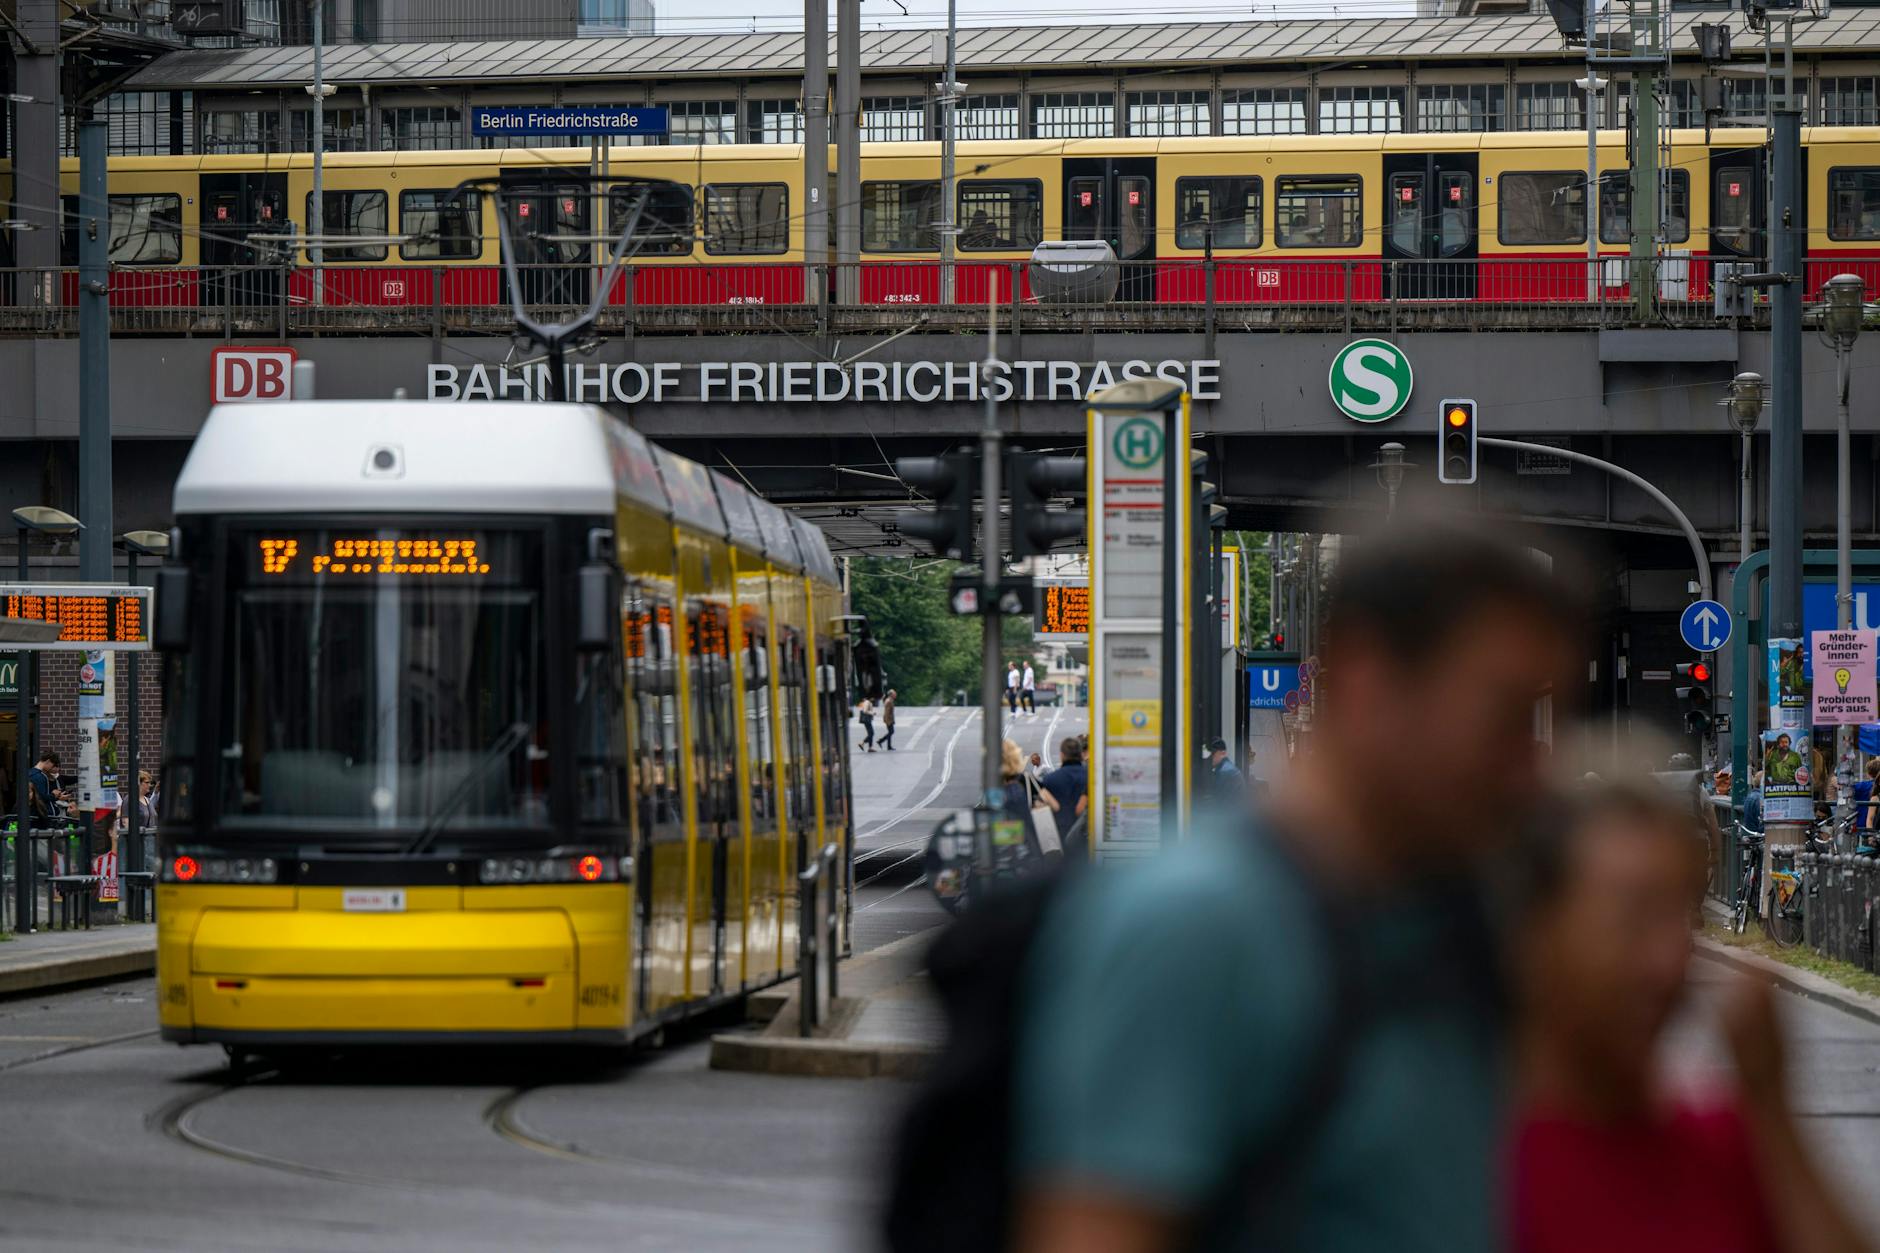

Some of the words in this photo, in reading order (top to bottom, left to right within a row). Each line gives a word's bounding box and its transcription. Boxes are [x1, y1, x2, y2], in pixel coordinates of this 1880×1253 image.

[480, 113, 523, 128] Berlin
[528, 112, 639, 128] Friedrichstraße
[1260, 272, 1278, 284] DB
[384, 282, 403, 295] DB
[223, 357, 285, 398] DB
[1341, 345, 1399, 416] S
[1126, 429, 1151, 458] H
[1829, 633, 1857, 642] Mehr
[1819, 642, 1868, 651] Gründer-
[1262, 669, 1280, 692] U
[1818, 696, 1871, 705] Probieren
[1819, 704, 1844, 713] wir's
[1846, 705, 1870, 713] aus.
